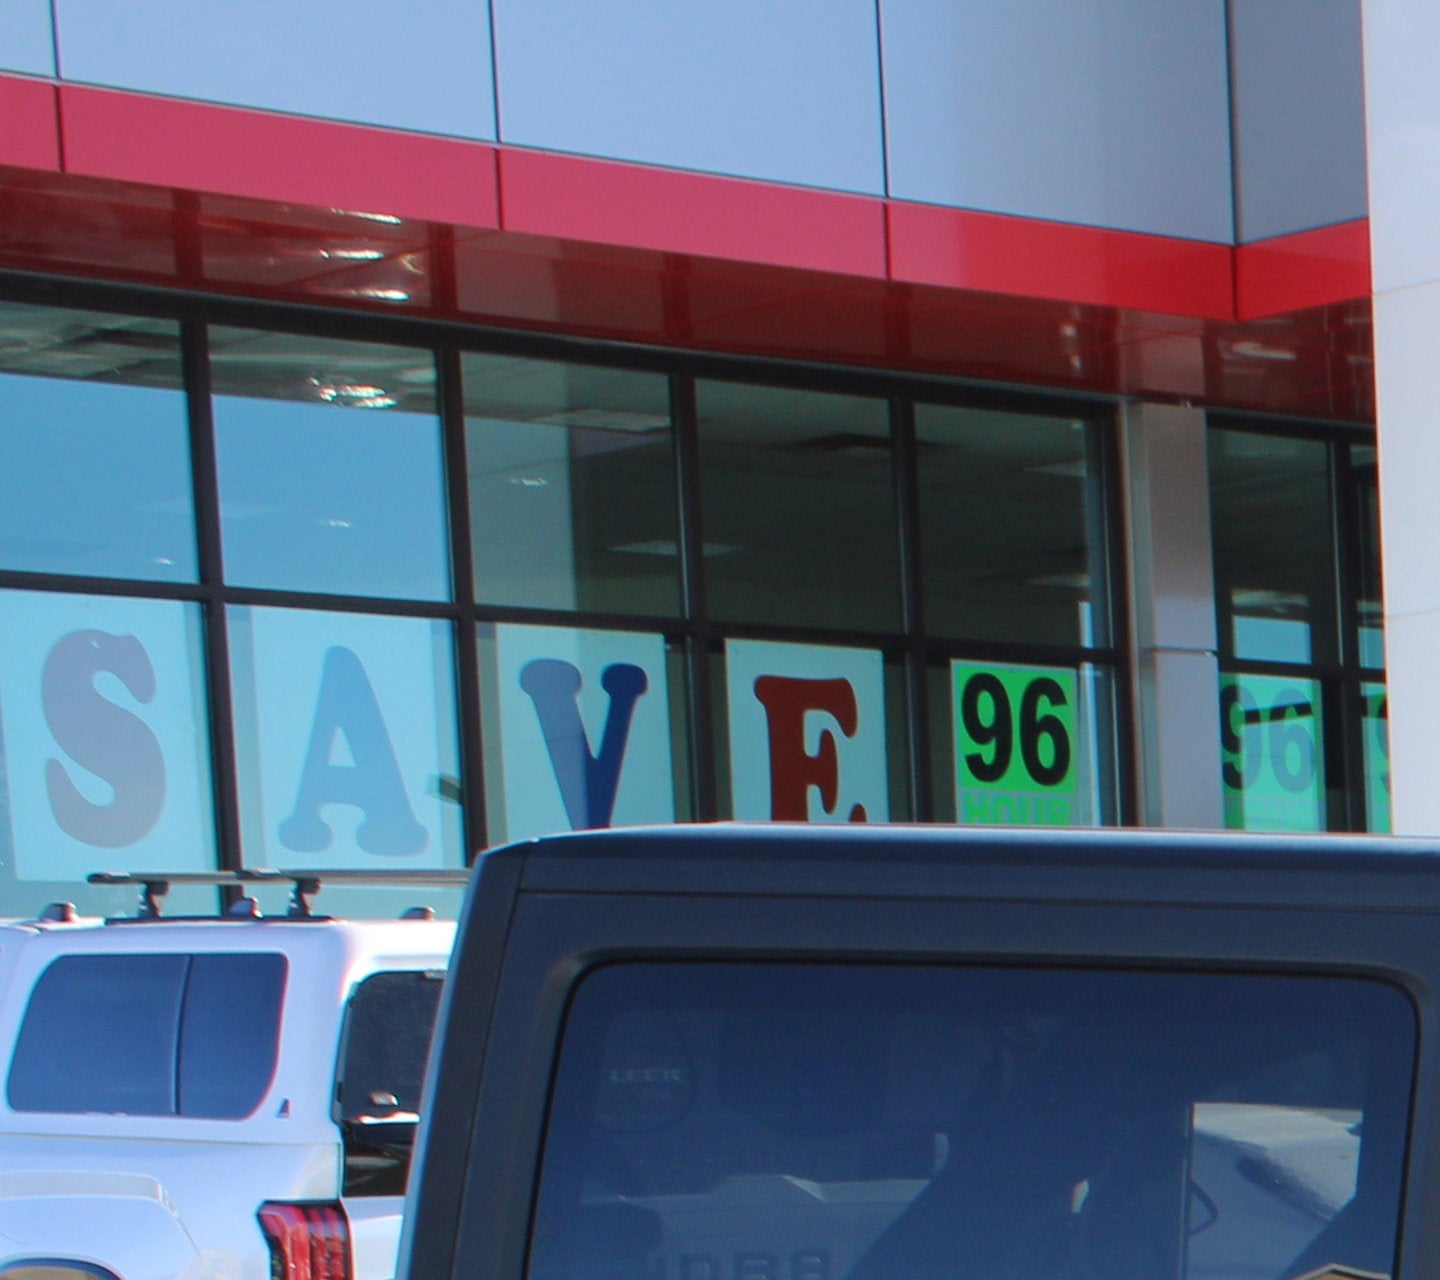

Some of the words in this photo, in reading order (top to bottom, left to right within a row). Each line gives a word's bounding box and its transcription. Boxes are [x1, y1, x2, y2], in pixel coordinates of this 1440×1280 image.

[41, 628, 868, 857] SAVE
[961, 672, 1071, 787] 96
[1220, 684, 1315, 794] 96
